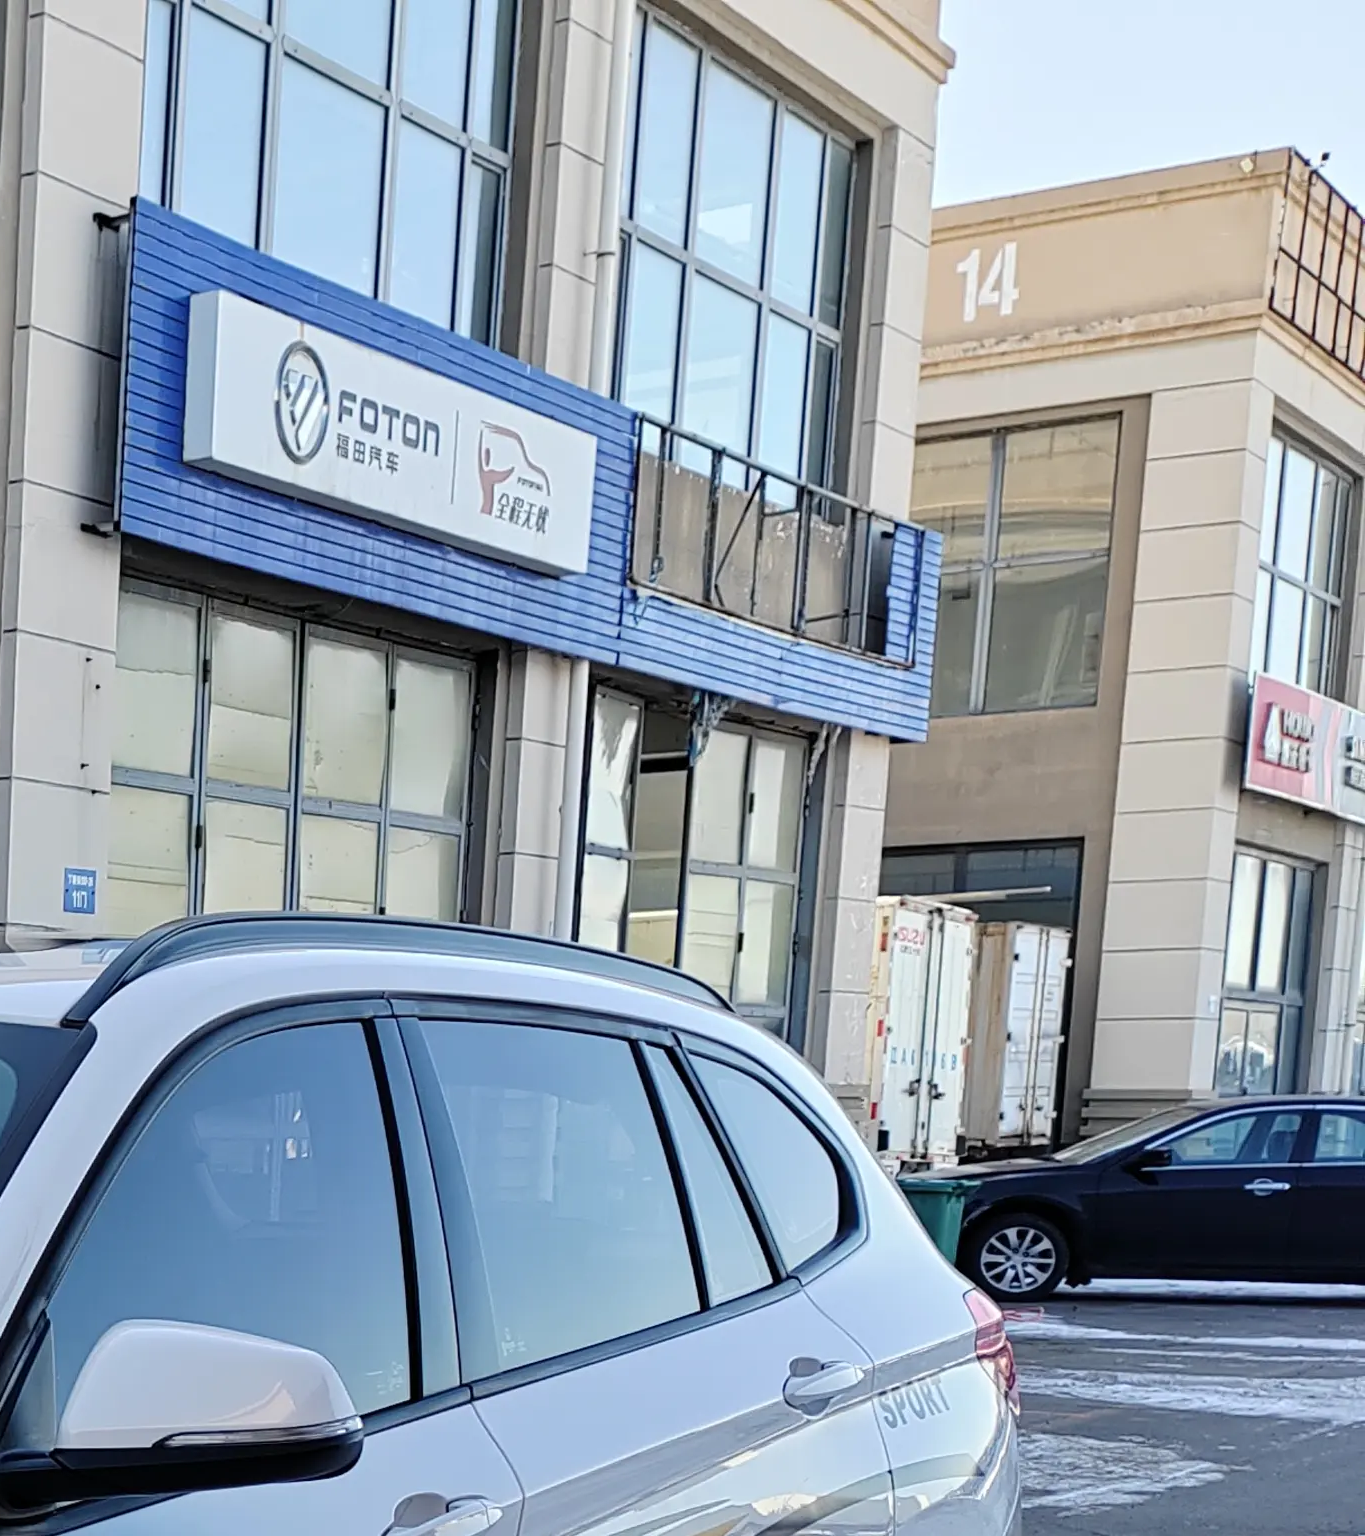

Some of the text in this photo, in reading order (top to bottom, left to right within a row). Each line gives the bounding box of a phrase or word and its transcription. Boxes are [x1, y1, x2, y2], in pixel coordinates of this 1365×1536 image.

[956, 241, 1020, 322] 14
[337, 389, 441, 457] FOTON
[335, 432, 400, 476] 福田汽车
[494, 492, 551, 536] 全程无忧
[878, 1377, 950, 1429] SPORT
